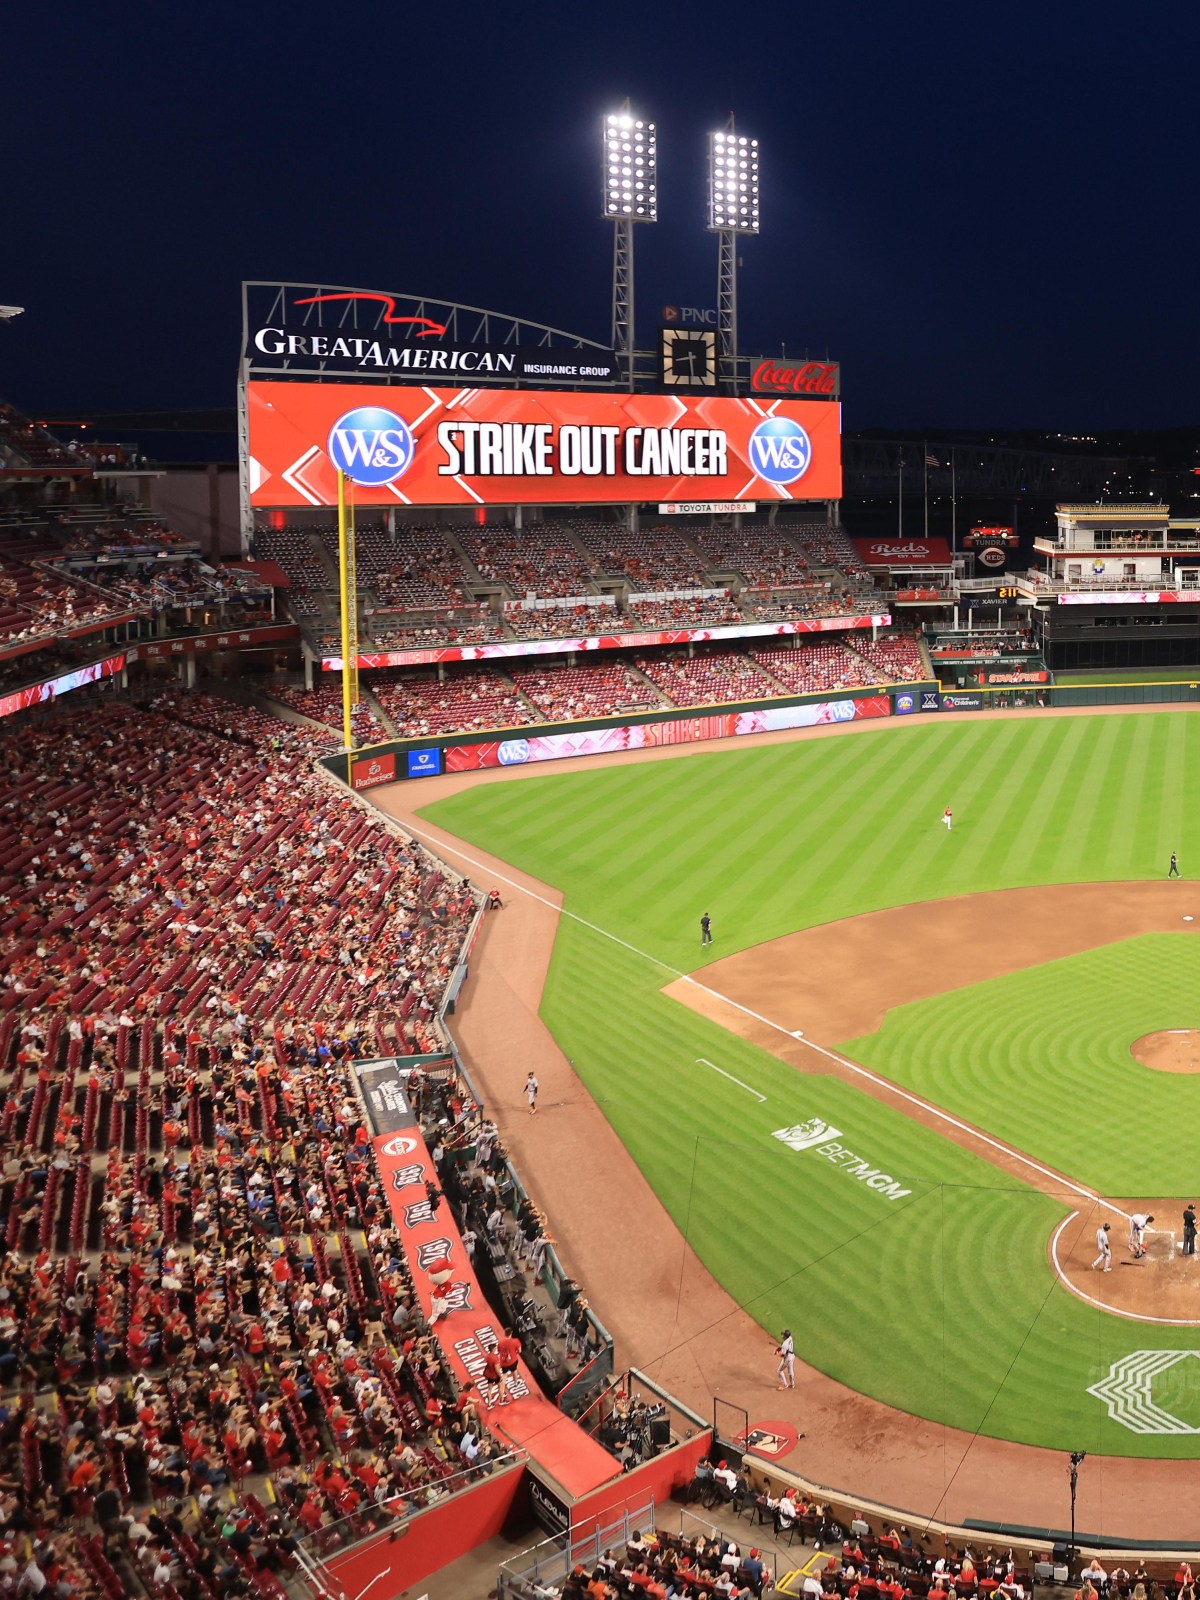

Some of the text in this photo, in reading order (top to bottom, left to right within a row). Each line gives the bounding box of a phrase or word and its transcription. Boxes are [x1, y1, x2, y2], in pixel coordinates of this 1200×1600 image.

[680, 307, 717, 324] PNC
[523, 363, 611, 377] INSURANCE GROUP
[335, 428, 405, 468] W&S
[437, 420, 728, 477] STRIKE OUT CANCER
[753, 435, 806, 470] W&S
[678, 503, 748, 513] TOYOTA TUNDRA
[870, 542, 930, 557] Reds
[975, 539, 1007, 547] TUNDRA
[985, 554, 1006, 562] REDS
[499, 747, 529, 765] W&S
[355, 771, 394, 789] Budweiser
[815, 1142, 913, 1201] BETMGM
